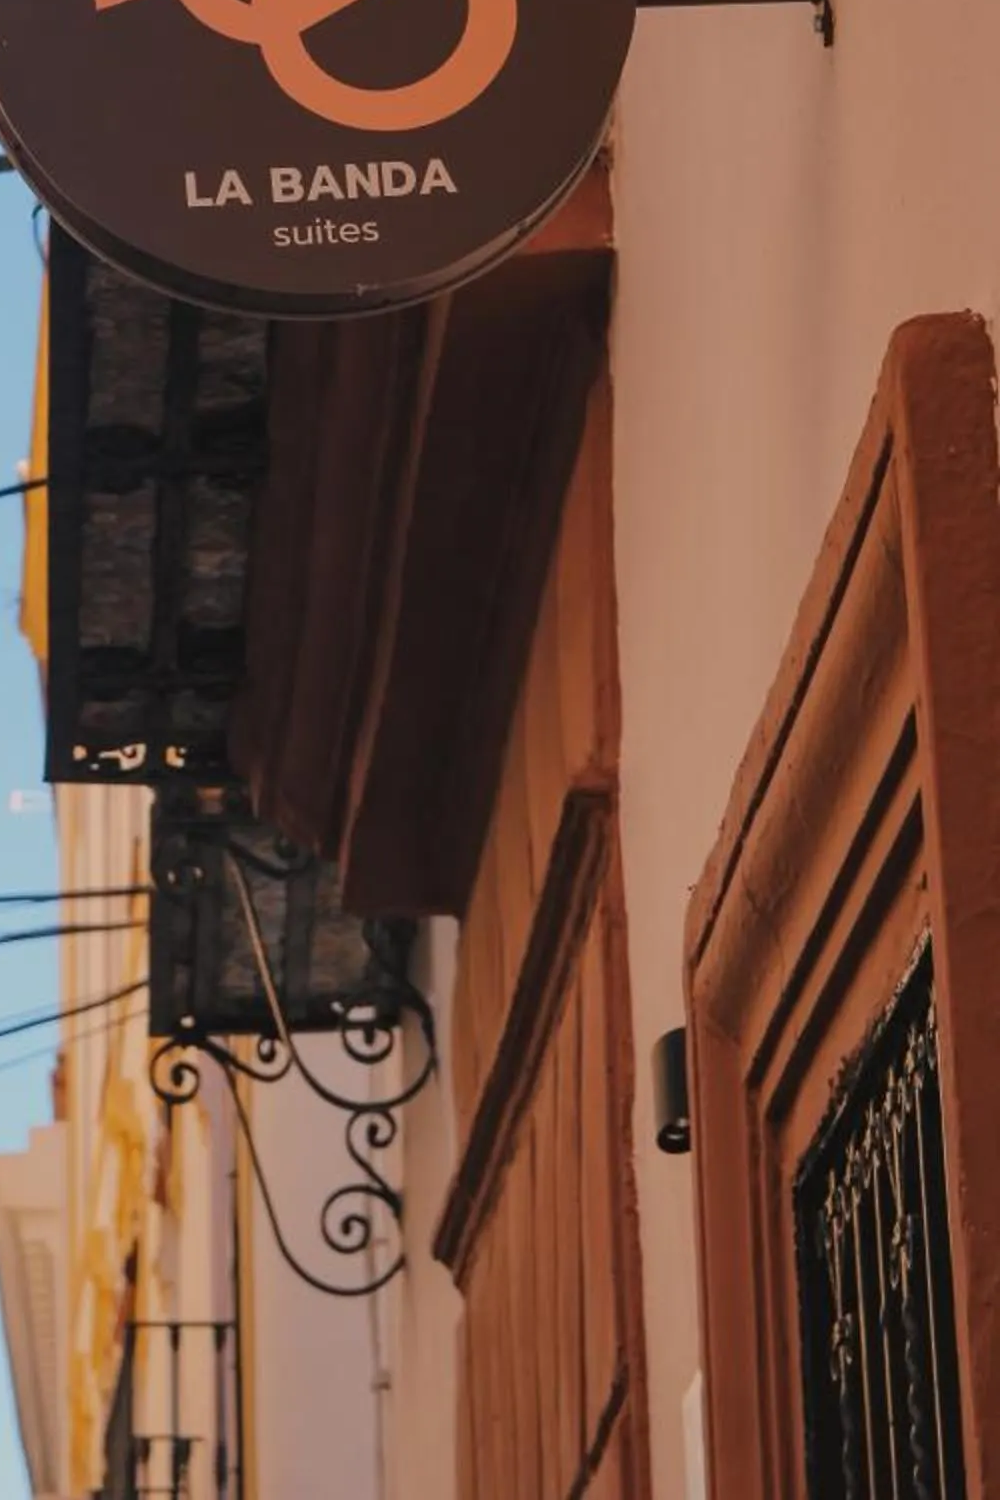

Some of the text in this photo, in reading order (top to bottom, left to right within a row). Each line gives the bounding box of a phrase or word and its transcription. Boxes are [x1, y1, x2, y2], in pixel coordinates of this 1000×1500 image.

[184, 158, 458, 208] LA BANDA
[273, 217, 380, 247] suites
